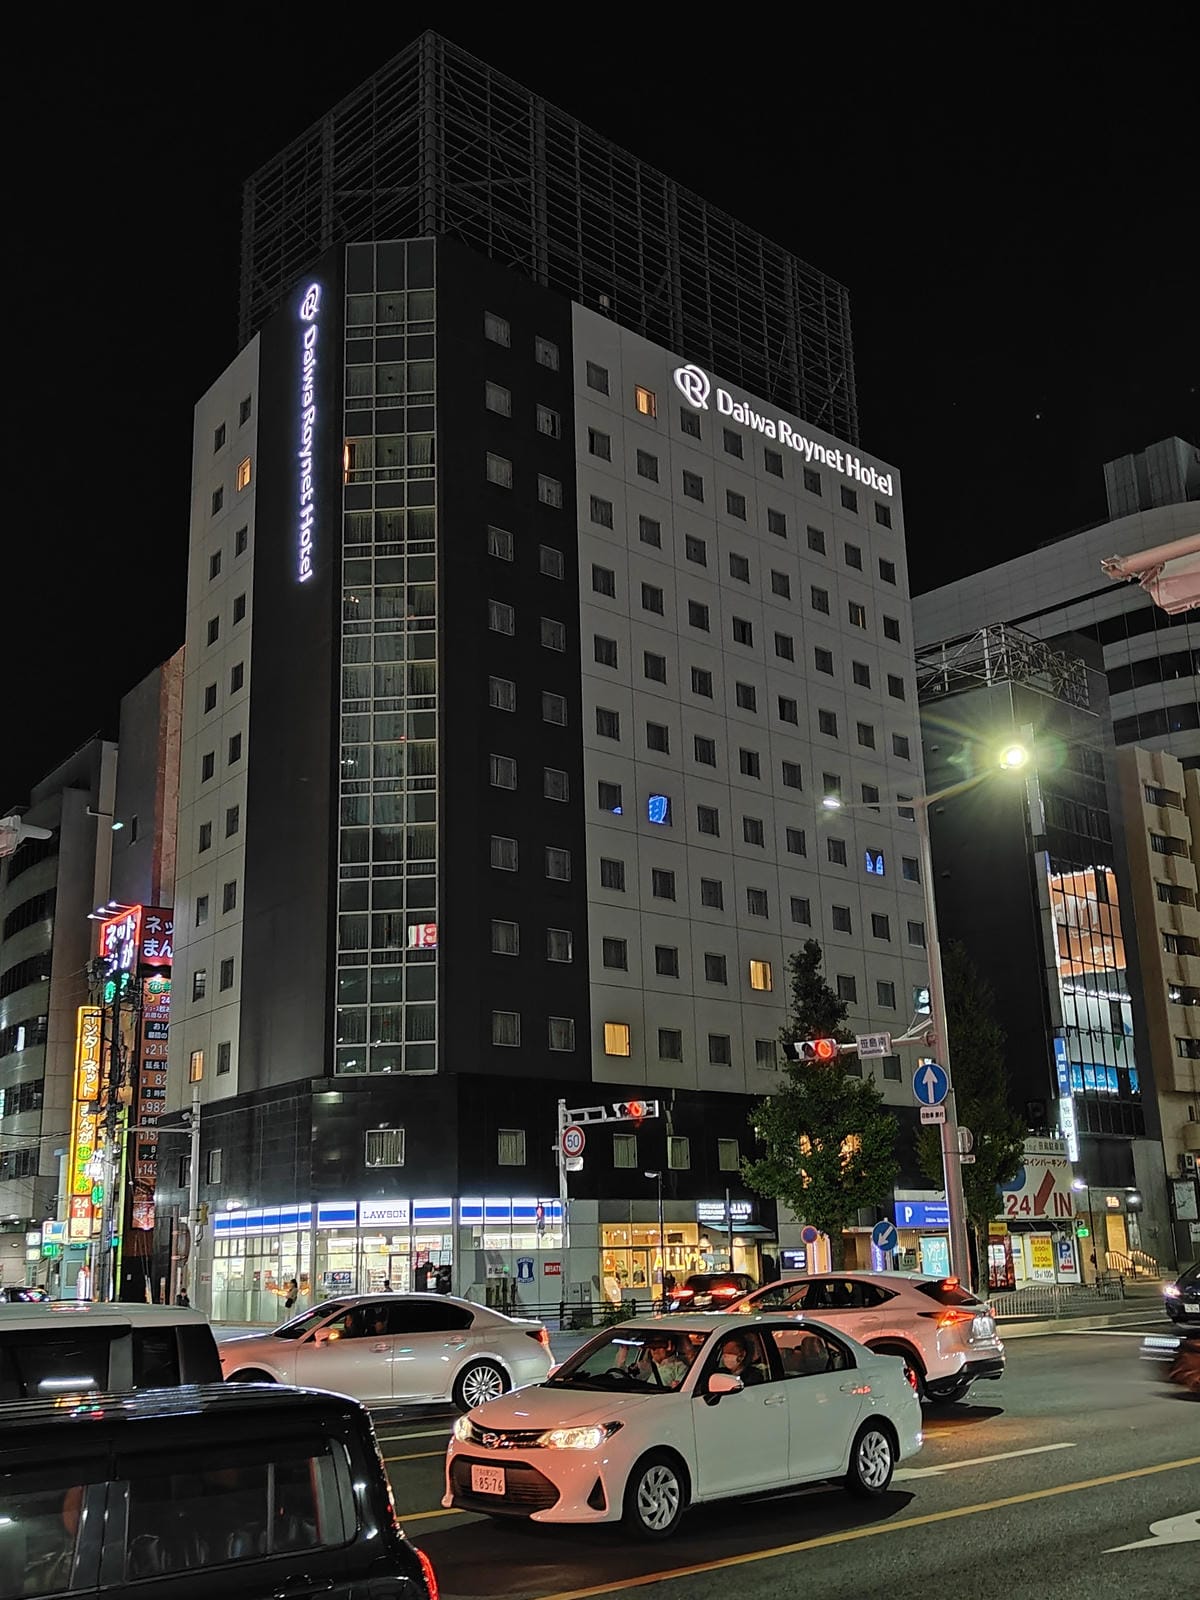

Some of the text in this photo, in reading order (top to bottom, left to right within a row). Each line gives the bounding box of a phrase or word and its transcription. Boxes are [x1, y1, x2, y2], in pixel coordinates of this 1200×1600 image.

[716, 387, 893, 497] Daiwa Roynet Hotel
[299, 323, 317, 582] Daiwa Roynet Hotel
[567, 1134, 580, 1149] 50
[74, 1198, 89, 1209] 24
[1006, 1194, 1031, 1216] 24
[1053, 1192, 1073, 1217] IN
[76, 1209, 86, 1218] H
[363, 1209, 407, 1220] LAWSON
[904, 1206, 913, 1223] P
[1060, 1242, 1071, 1259] P
